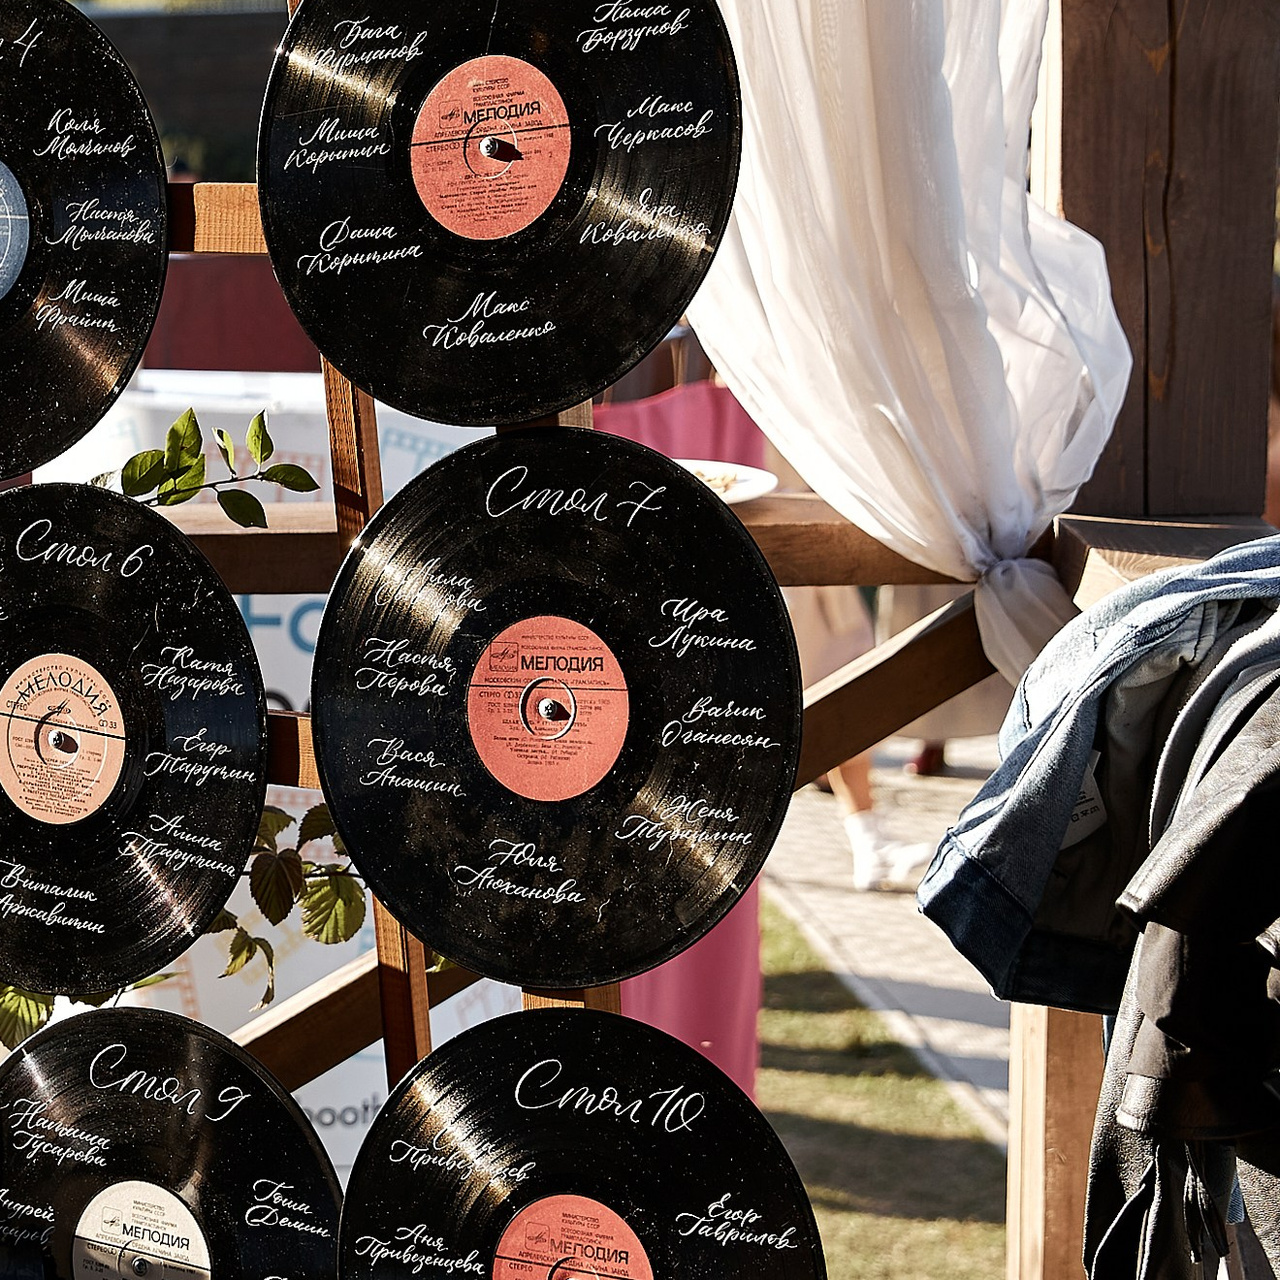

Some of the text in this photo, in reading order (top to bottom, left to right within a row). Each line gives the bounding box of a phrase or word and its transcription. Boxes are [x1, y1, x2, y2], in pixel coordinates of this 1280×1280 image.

[14, 17, 44, 67] 4
[576, 8, 690, 53] Борзунов
[47, 108, 106, 134] Коля
[463, 101, 541, 124] МЕЛОДИЯ
[627, 95, 693, 118] Макс
[33, 135, 136, 160] Молчанов
[299, 117, 379, 146] Миша
[593, 110, 713, 153] Черкасов
[45, 220, 155, 250] Молчанова
[319, 216, 397, 252] Даша
[297, 245, 423, 275] Корытина
[48, 279, 120, 307] Миша
[446, 290, 530, 324] Макс
[422, 319, 557, 350] Коваленко
[485, 465, 667, 526] Стол 7
[15, 519, 155, 578] Стол 6
[660, 597, 729, 629] Ира
[363, 637, 456, 672] Настя
[648, 625, 757, 658] Лукина
[160, 645, 238, 677] Катя
[520, 655, 604, 674] МЕЛОДИЯ
[19, 671, 108, 716] МЕЛОДИЯ
[141, 663, 246, 701] Назарова
[354, 667, 449, 698] Перова
[173, 727, 232, 760] Егор
[661, 720, 781, 749] Оганесян
[367, 737, 445, 767] Вася
[143, 752, 257, 787] Тарутин
[659, 794, 739, 823] Женя
[148, 814, 223, 852] Алина
[488, 839, 563, 872] Юля
[89, 1044, 201, 1116] Стол
[205, 1086, 252, 1121] 9
[514, 1059, 705, 1133] Стол 10
[12, 1130, 108, 1166] Гусарова
[245, 1204, 330, 1238] Демин
[707, 1193, 762, 1224] Егор
[122, 1223, 189, 1250] МЕЛОДИЯ
[394, 1224, 448, 1253] Аня
[676, 1212, 798, 1250] Гаврилов
[355, 1236, 486, 1275] Привезенцева
[550, 1238, 629, 1265] МЕЛОДИЯ
